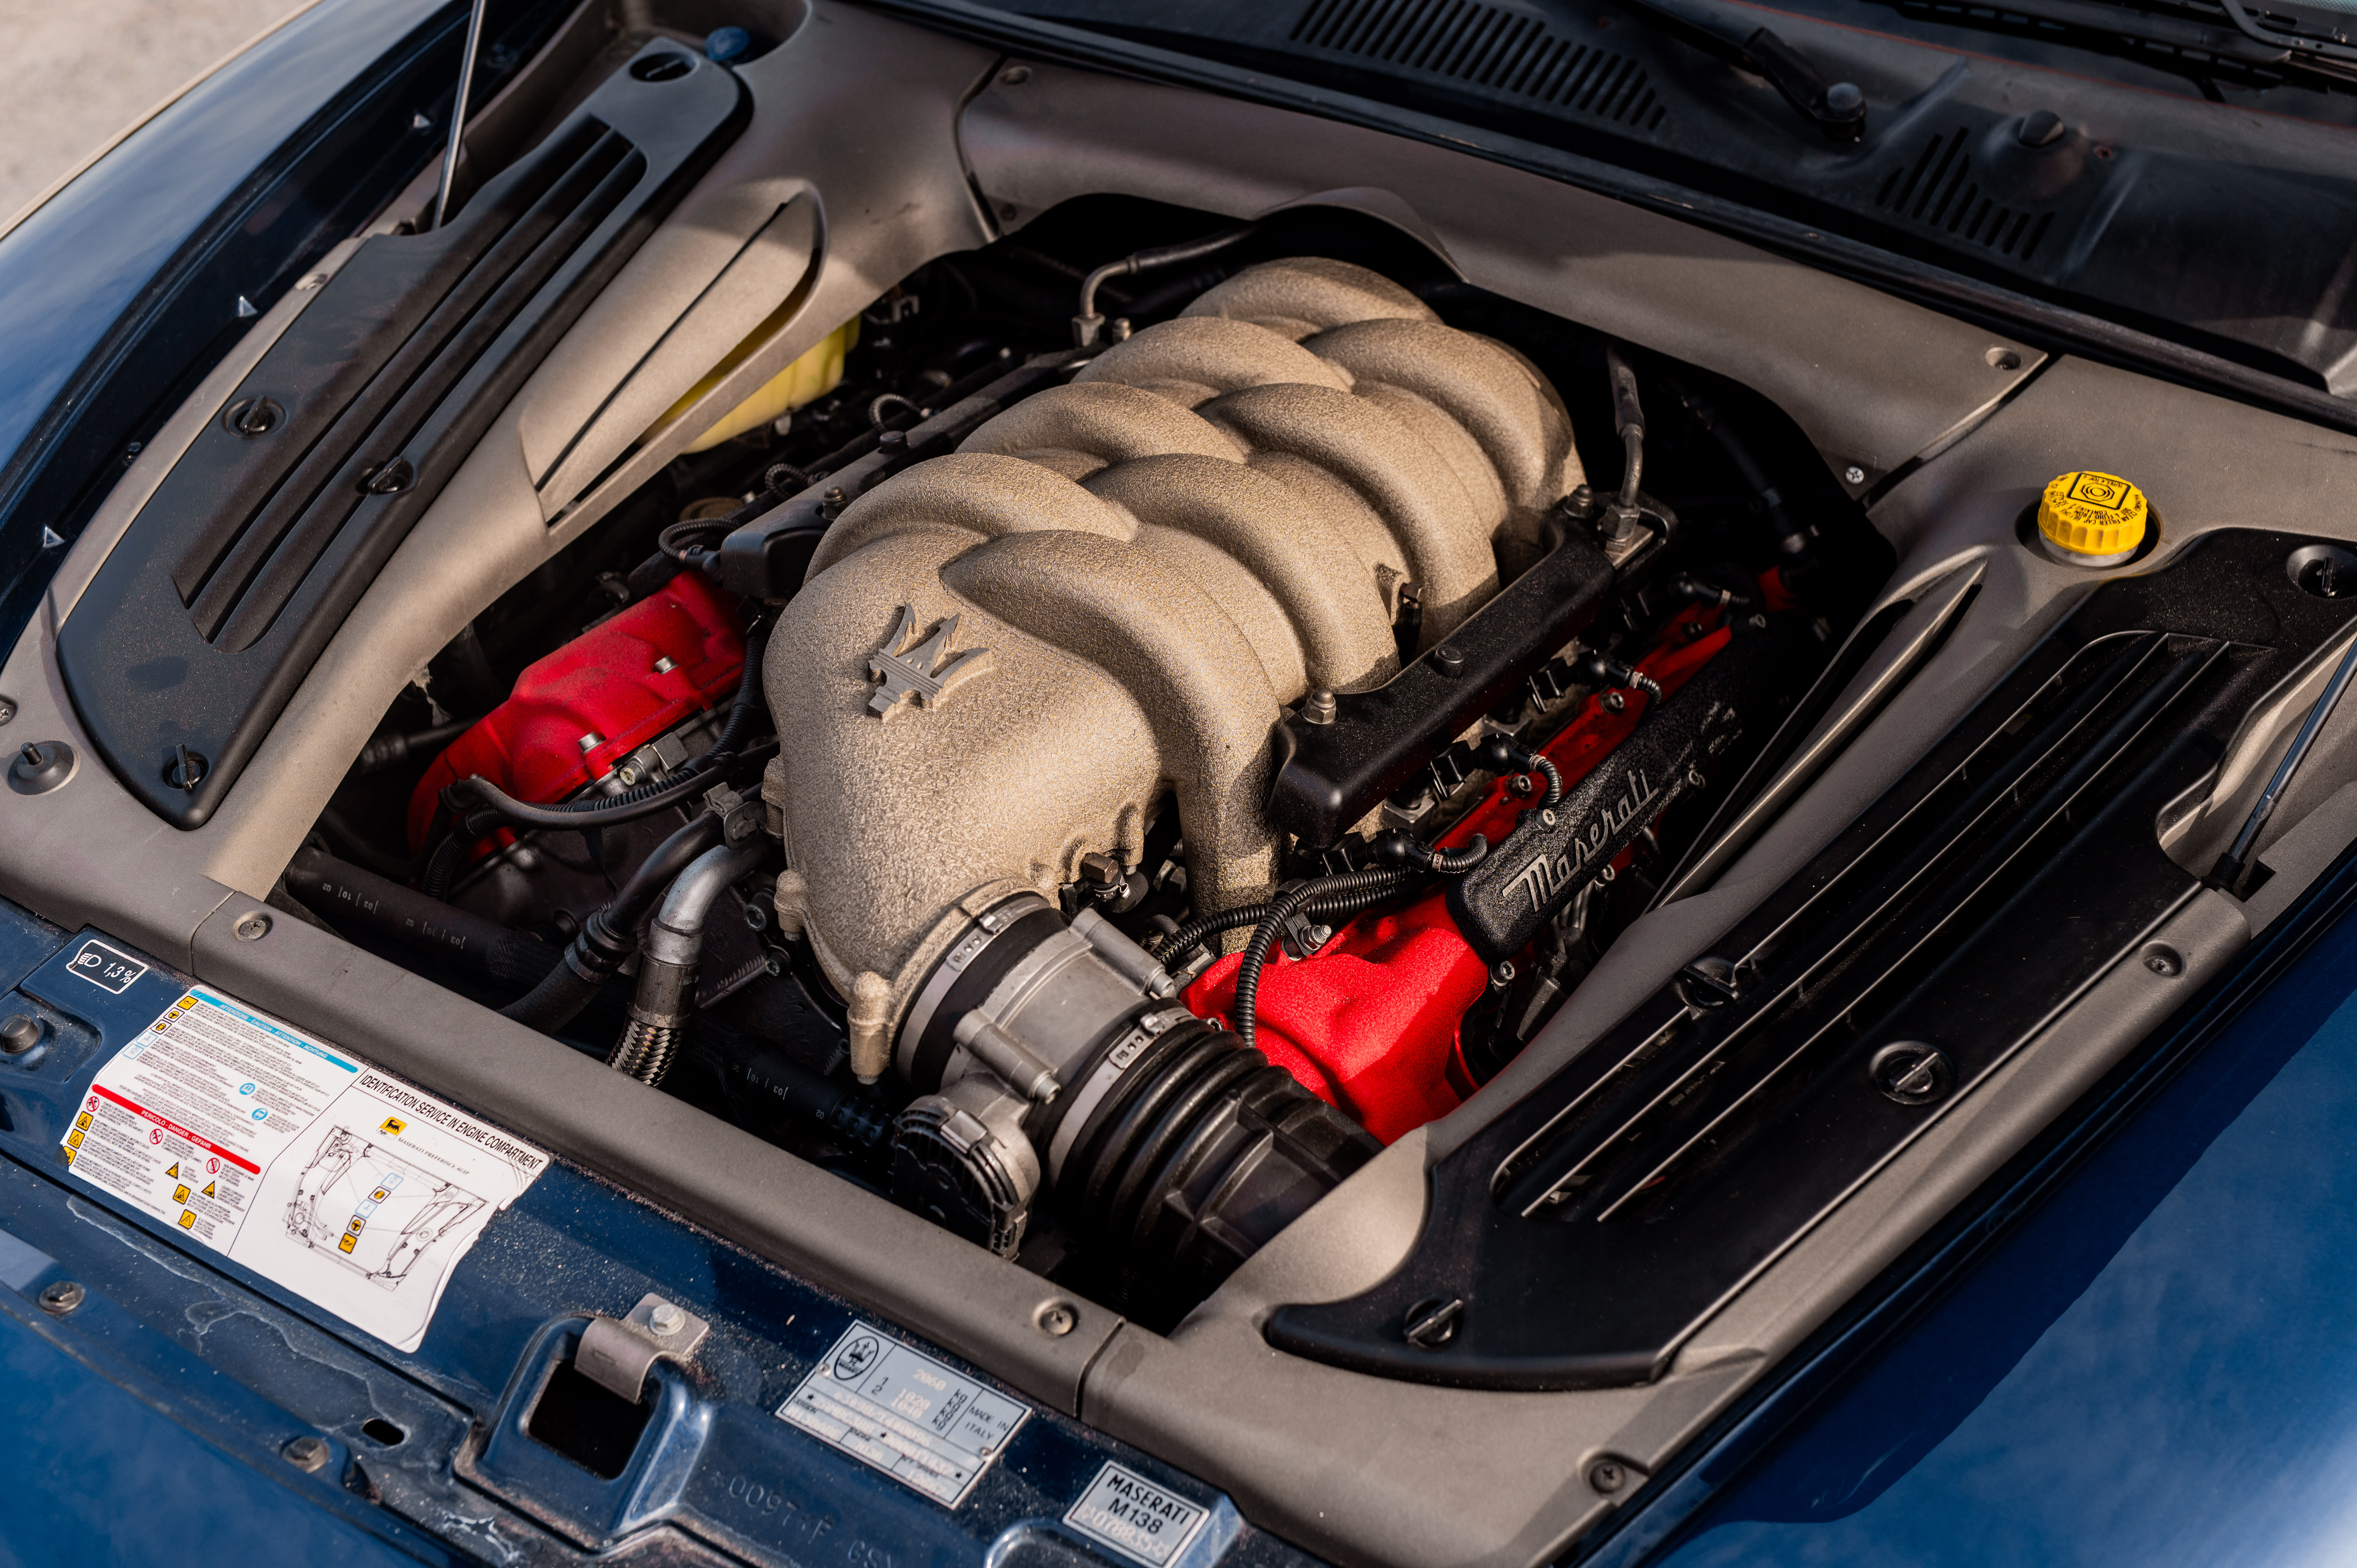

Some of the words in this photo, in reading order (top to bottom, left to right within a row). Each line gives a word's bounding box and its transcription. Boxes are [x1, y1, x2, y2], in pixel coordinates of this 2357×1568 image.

[2121, 511, 2137, 522] CLEAN
[1502, 769, 1659, 912] Maserati
[220, 1005, 249, 1020] ATTENZIONE
[251, 1019, 272, 1031] CAUTION
[274, 1031, 301, 1045] ATTENTION
[304, 1045, 327, 1058] ACHTUNG
[141, 1111, 165, 1125] PERICOLO
[168, 1124, 189, 1137] DANGER
[191, 1136, 211, 1148] GEFAHR
[360, 1075, 420, 1108] IDENTIFICATION
[416, 1102, 451, 1124] SERVICE
[447, 1118, 460, 1128] IN
[456, 1122, 488, 1142] ENGINE
[485, 1136, 542, 1169] COMPARTMENT
[399, 1138, 424, 1152] MASERATI
[912, 1368, 947, 1391] 2060
[963, 1421, 995, 1441] ITALY
[967, 1406, 994, 1424] MADE
[996, 1420, 1011, 1431] IN
[1107, 1474, 1190, 1525] MASERATI
